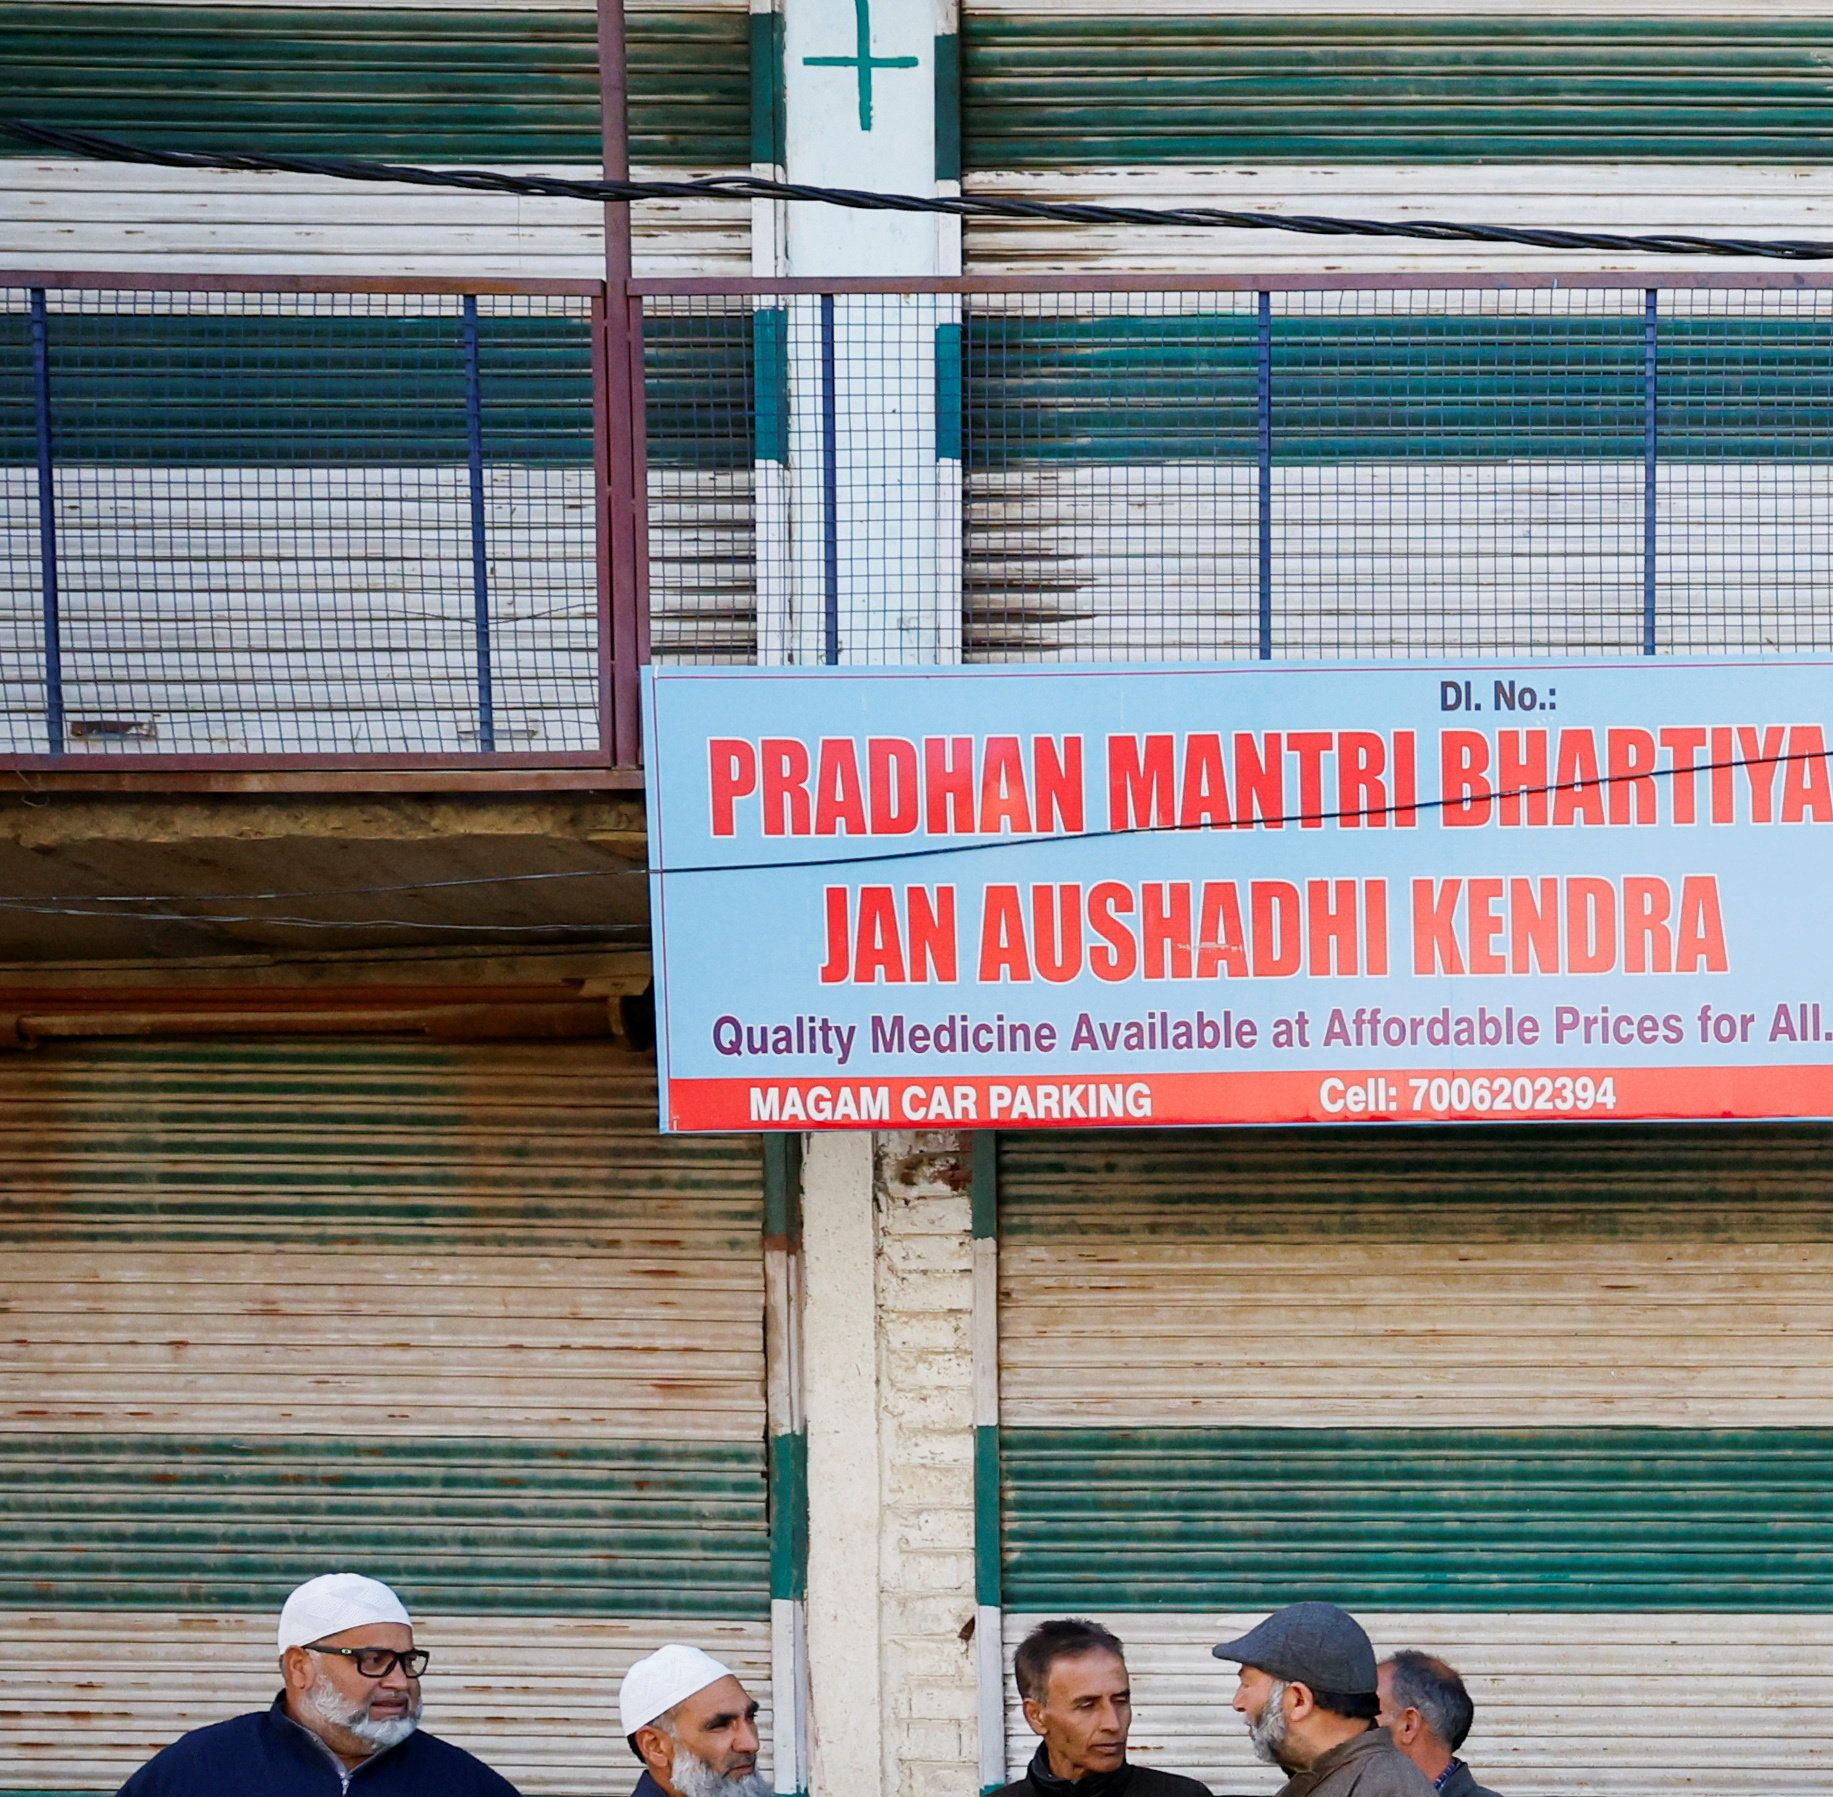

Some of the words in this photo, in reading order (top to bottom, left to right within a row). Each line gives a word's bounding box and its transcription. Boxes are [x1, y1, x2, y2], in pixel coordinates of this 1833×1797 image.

[1493, 680, 1557, 712] No.:
[709, 735, 1086, 837] PRADHAN
[1107, 730, 1418, 833] MANTRI
[820, 885, 958, 984] JAN
[978, 879, 1388, 984] AUSHADHI
[1411, 875, 1730, 976] KENDRA
[712, 1015, 857, 1066] Quality
[870, 1013, 1058, 1055] Medicine
[1069, 1009, 1259, 1052] Available
[1271, 1010, 1311, 1049] at
[1324, 1005, 1540, 1048] Affordable
[1555, 1005, 1685, 1046] Prices
[1697, 1003, 1756, 1044] for
[749, 1084, 891, 1122] MAGAM
[900, 1084, 979, 1122] CAR
[988, 1081, 1153, 1121] PARKING
[1318, 1077, 1398, 1114] Cell:
[1407, 1075, 1618, 1113] 7006202394
